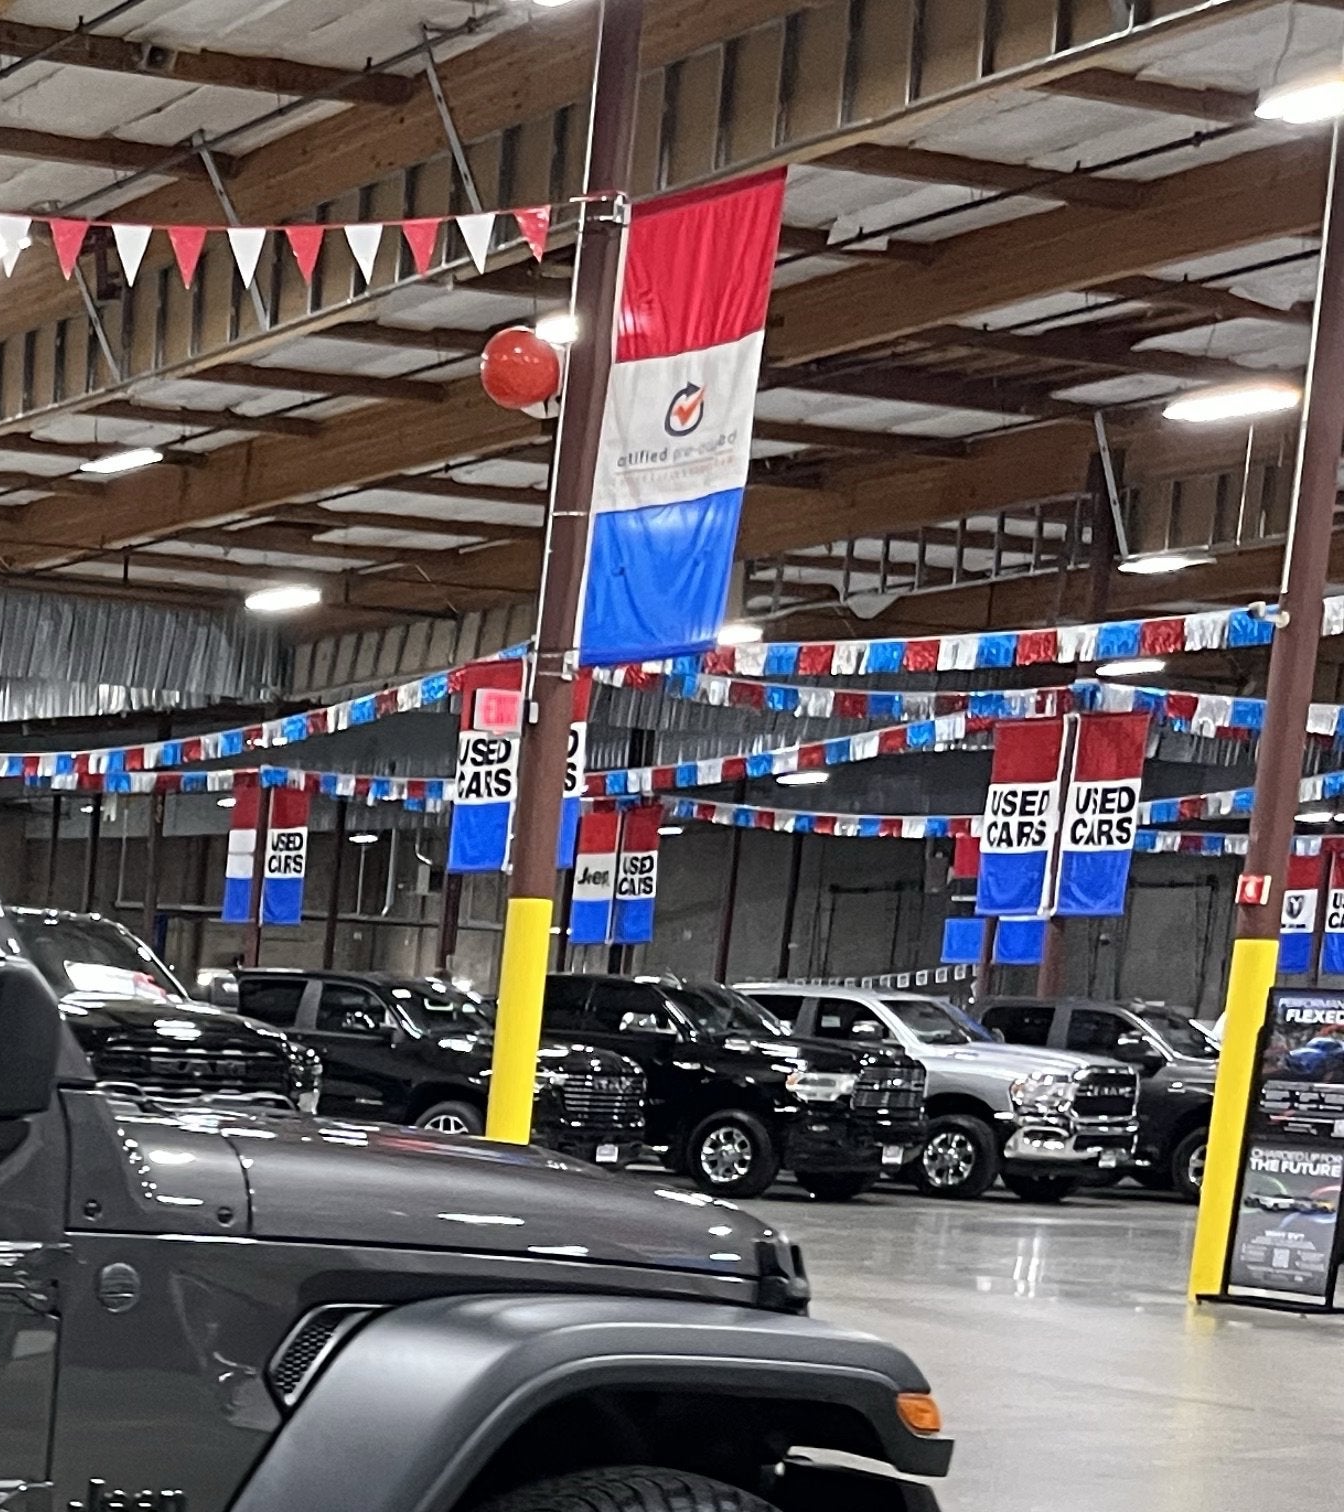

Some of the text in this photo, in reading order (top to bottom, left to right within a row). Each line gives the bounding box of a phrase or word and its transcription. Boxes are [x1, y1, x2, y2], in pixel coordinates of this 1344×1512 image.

[992, 790, 1051, 817] USED
[987, 820, 1047, 848] CARS
[1070, 817, 1133, 846] CARS
[1250, 1157, 1341, 1178] THE FUTURE
